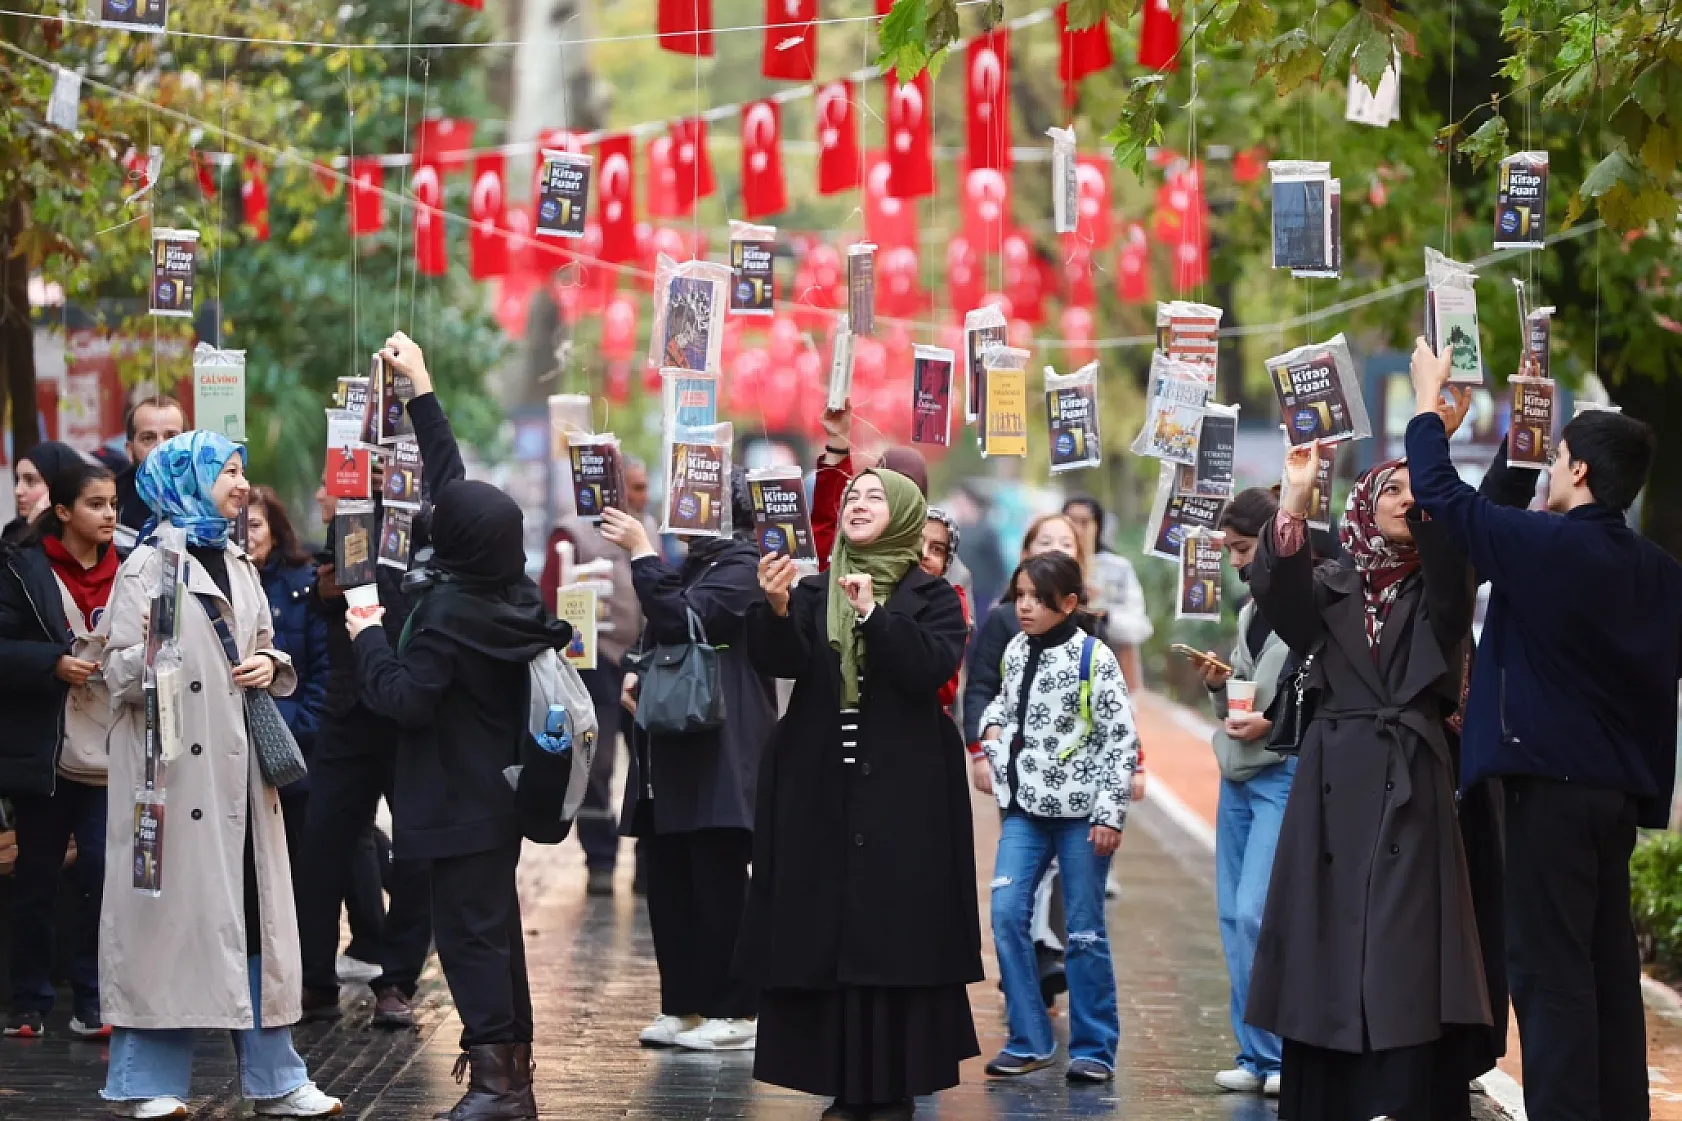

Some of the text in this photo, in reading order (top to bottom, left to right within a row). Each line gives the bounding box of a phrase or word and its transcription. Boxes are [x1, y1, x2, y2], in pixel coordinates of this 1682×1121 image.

[552, 168, 583, 182] Kitap
[1510, 174, 1540, 186] Kitap
[167, 248, 193, 262] Kitap
[743, 250, 771, 261] Kitap
[200, 375, 238, 384] CALVINO
[1292, 367, 1329, 383] Kitap
[1061, 398, 1090, 410] Kitap
[1524, 394, 1550, 408] Kitap
[581, 455, 604, 466] Kitap
[687, 456, 720, 473] Kitap
[764, 491, 797, 503] Kitap
